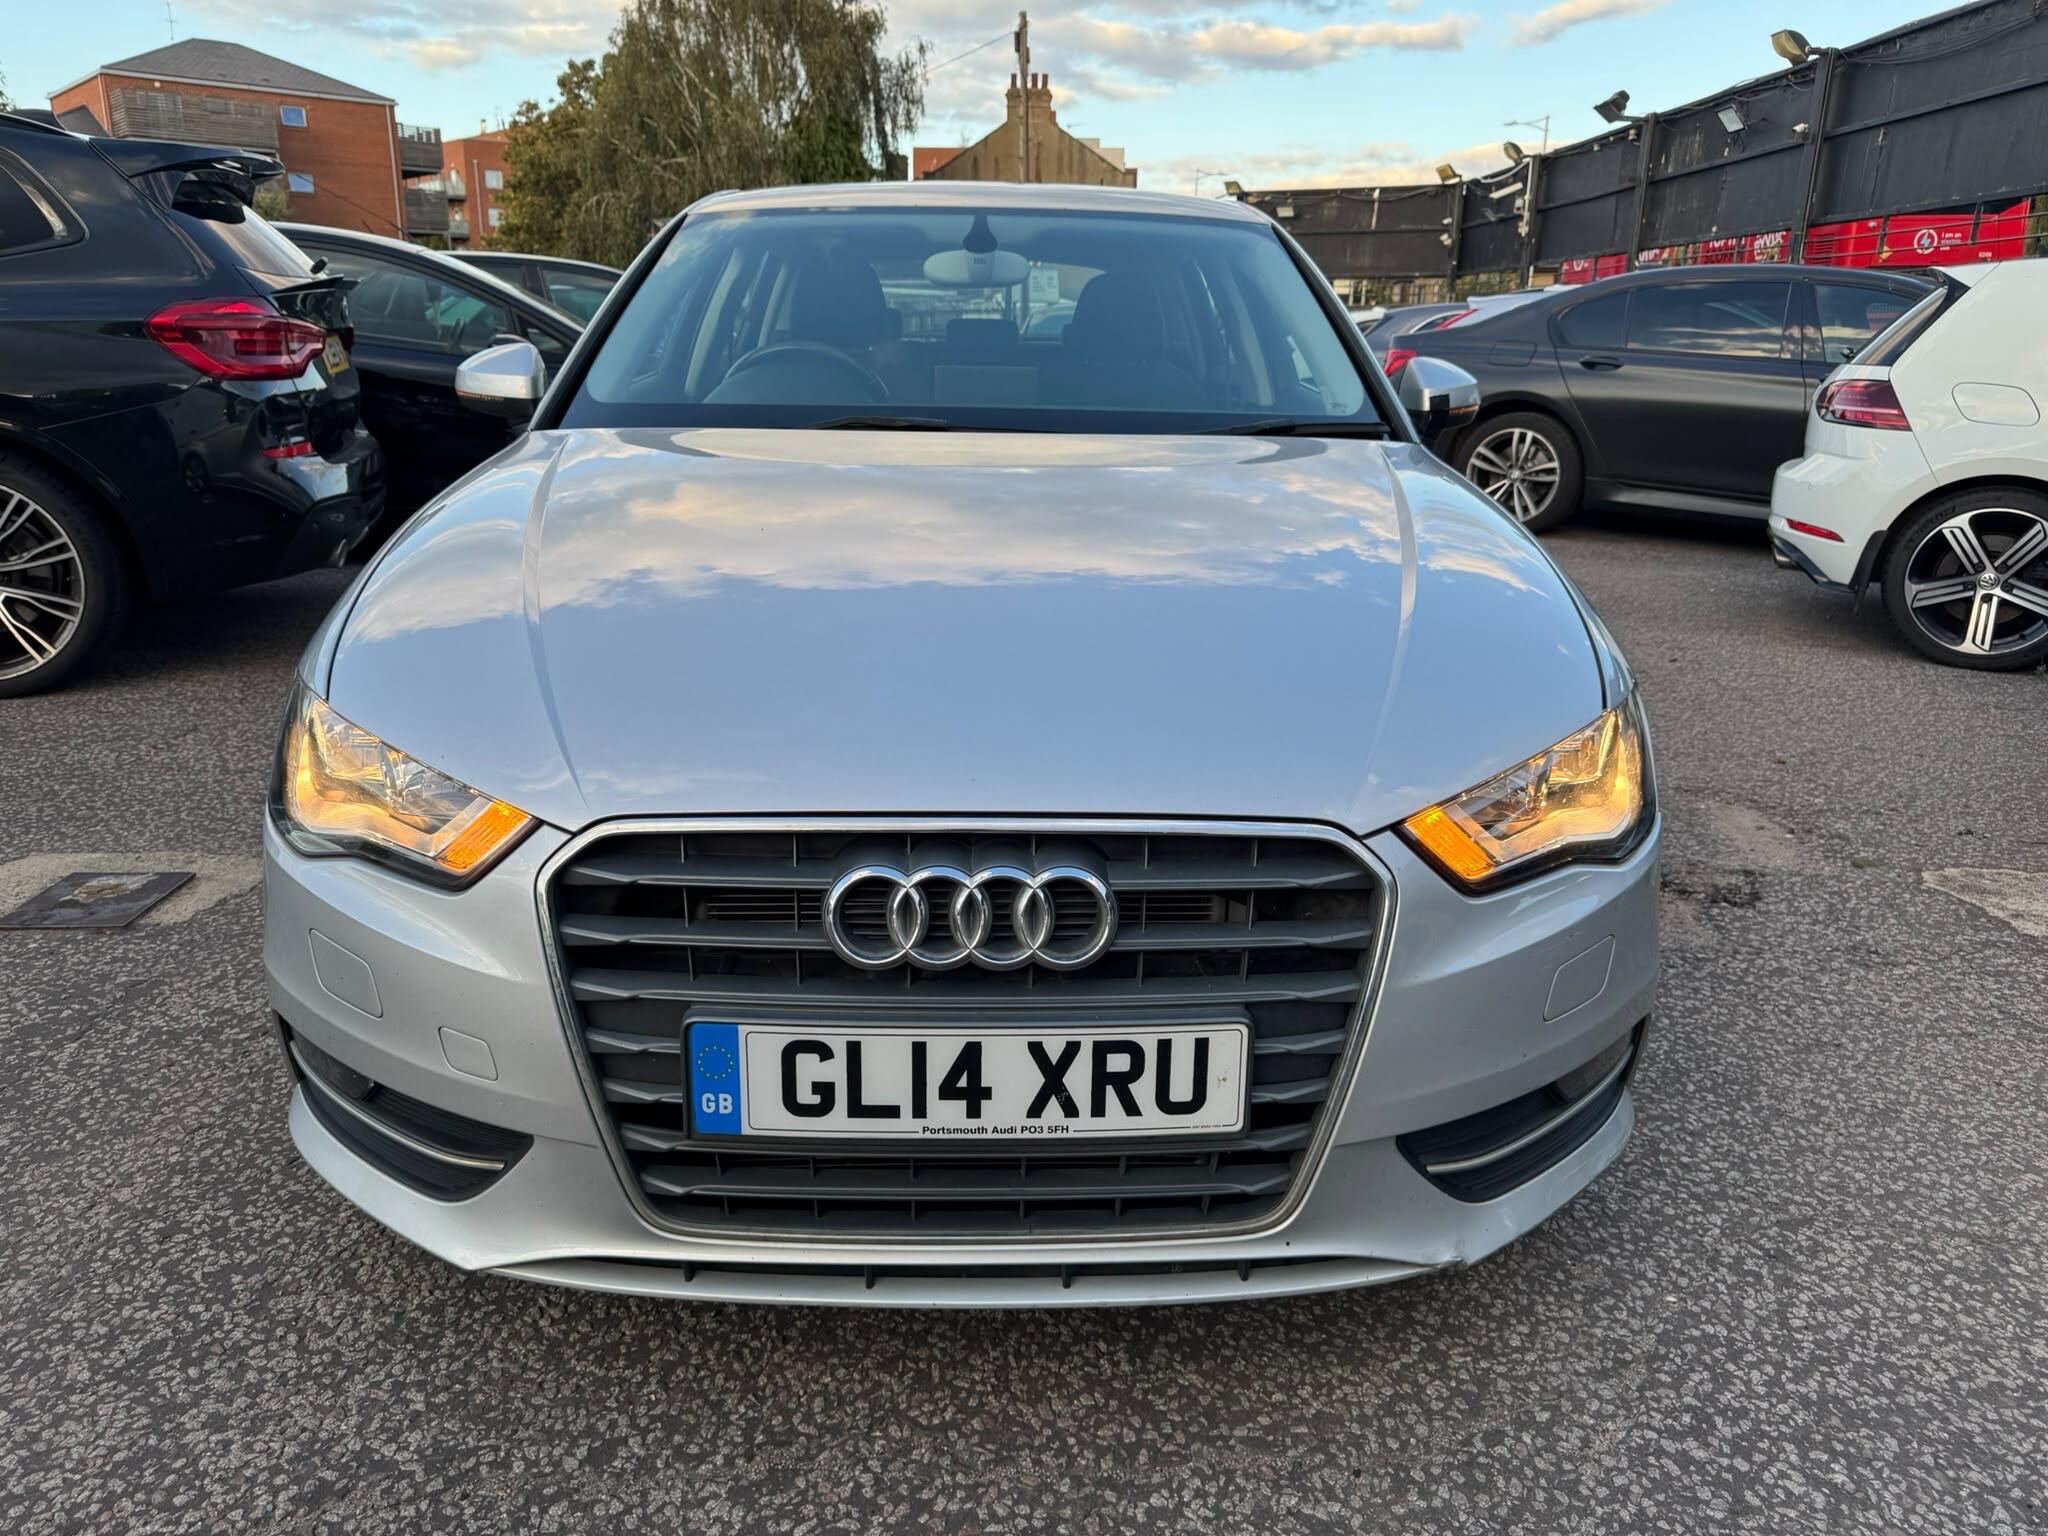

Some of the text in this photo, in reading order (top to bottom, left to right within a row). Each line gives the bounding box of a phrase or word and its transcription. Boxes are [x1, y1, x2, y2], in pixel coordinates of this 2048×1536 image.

[780, 1037, 1210, 1119] GL14 XRU
[701, 1092, 733, 1114] GB
[922, 1125, 1069, 1135] Portsmouth Audi PO3 5FH
